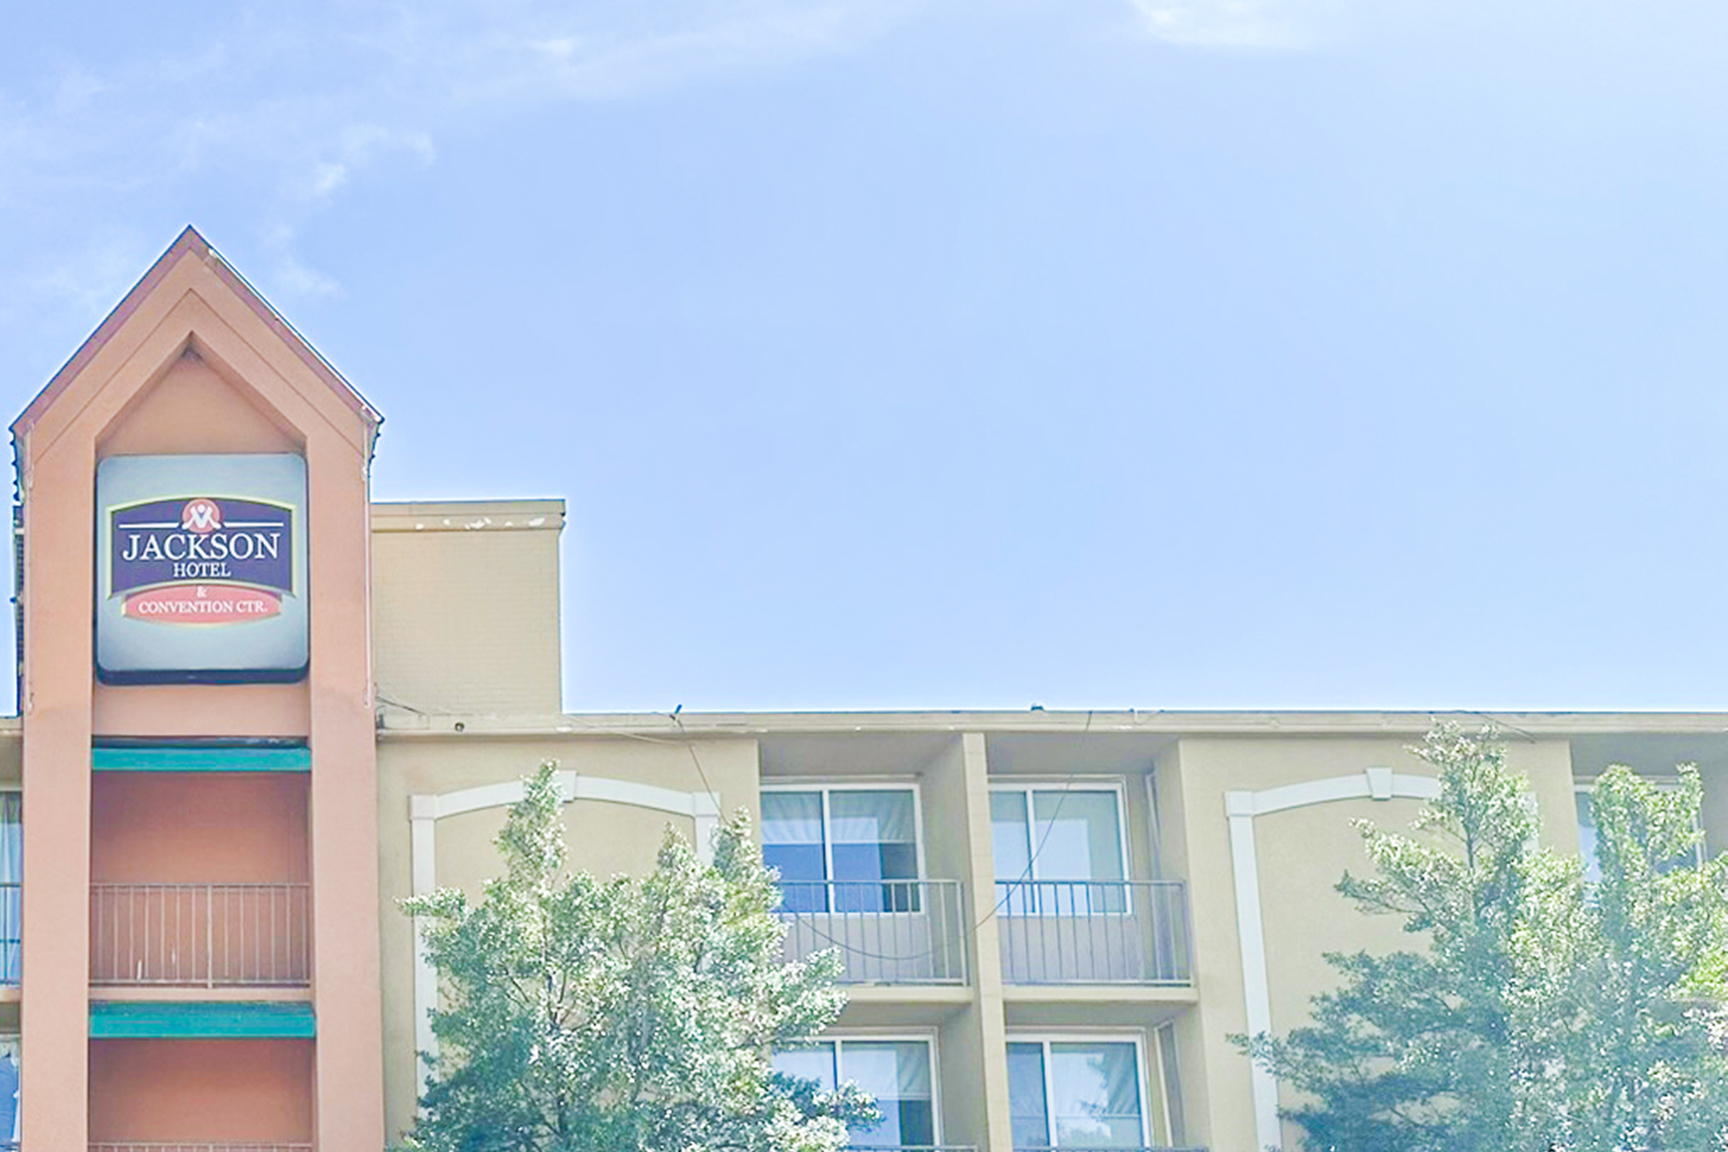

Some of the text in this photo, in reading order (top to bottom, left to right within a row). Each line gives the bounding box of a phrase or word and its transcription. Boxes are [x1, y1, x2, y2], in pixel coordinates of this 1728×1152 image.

[122, 533, 280, 560] JACKSON
[173, 562, 232, 578] HOTEL
[196, 585, 207, 599] &
[138, 600, 268, 614] CONVENTION CTR.
